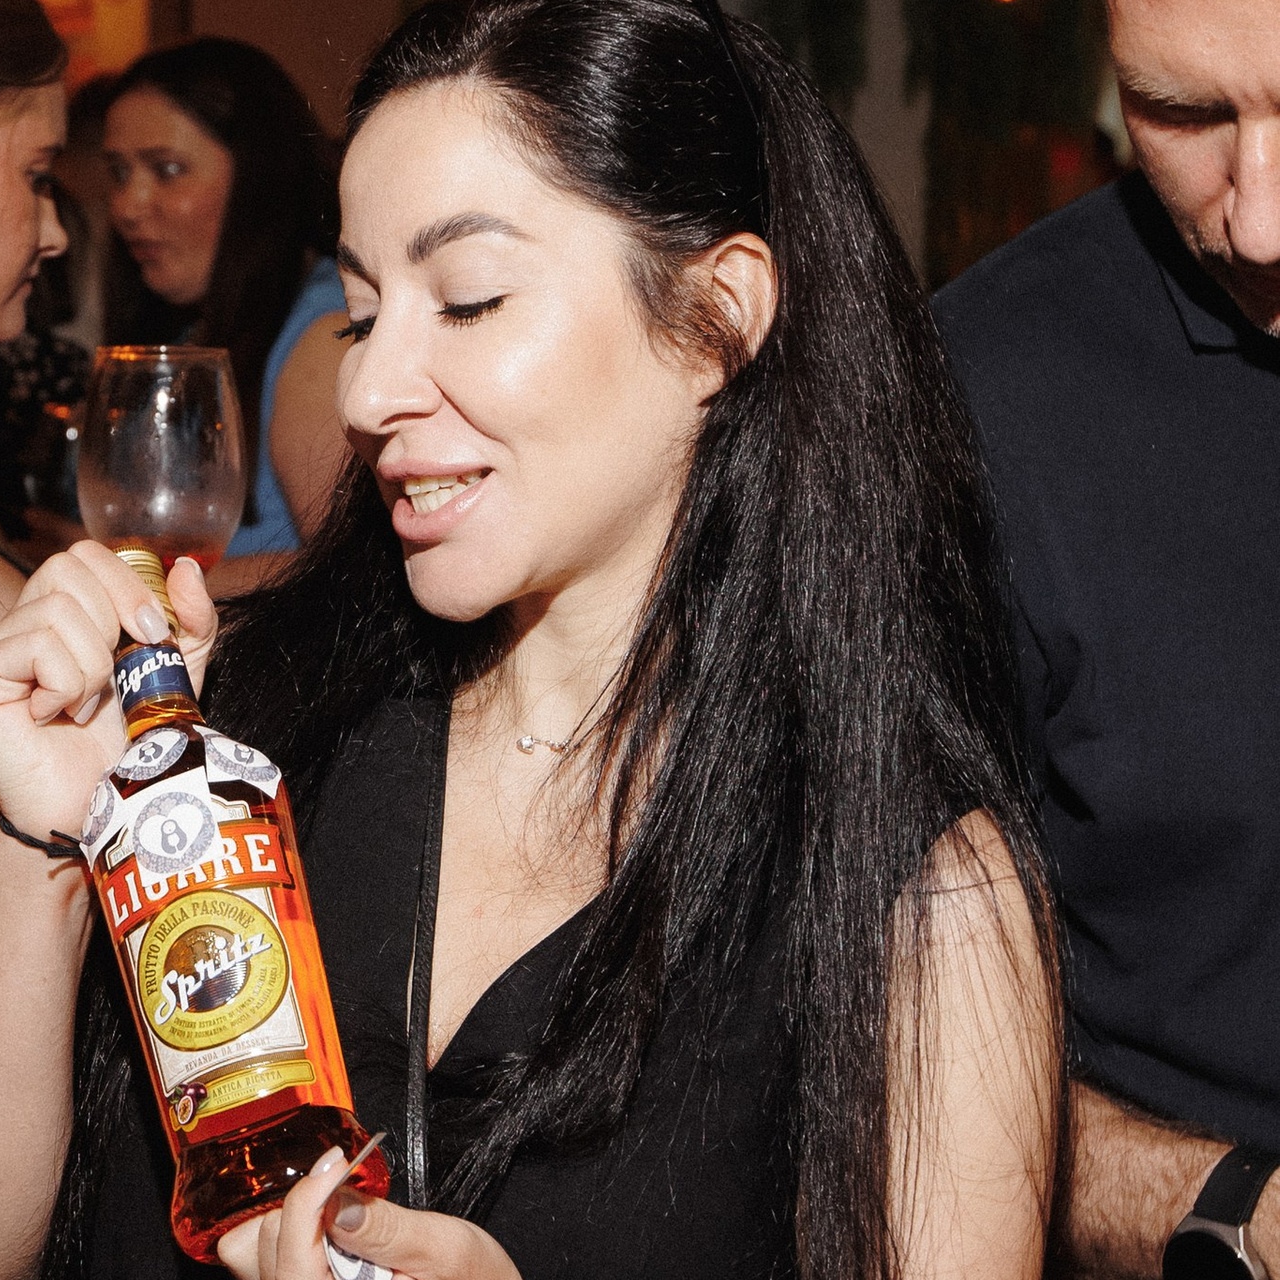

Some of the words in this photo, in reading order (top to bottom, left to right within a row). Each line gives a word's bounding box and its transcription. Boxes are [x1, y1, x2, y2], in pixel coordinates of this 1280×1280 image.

[144, 943, 161, 997] FRUTTO
[155, 907, 190, 944] DELLA
[191, 900, 256, 929] PASSIONE
[154, 933, 273, 1026] Spritz
[185, 1051, 219, 1073] BEVANDA
[221, 1045, 233, 1057] DA
